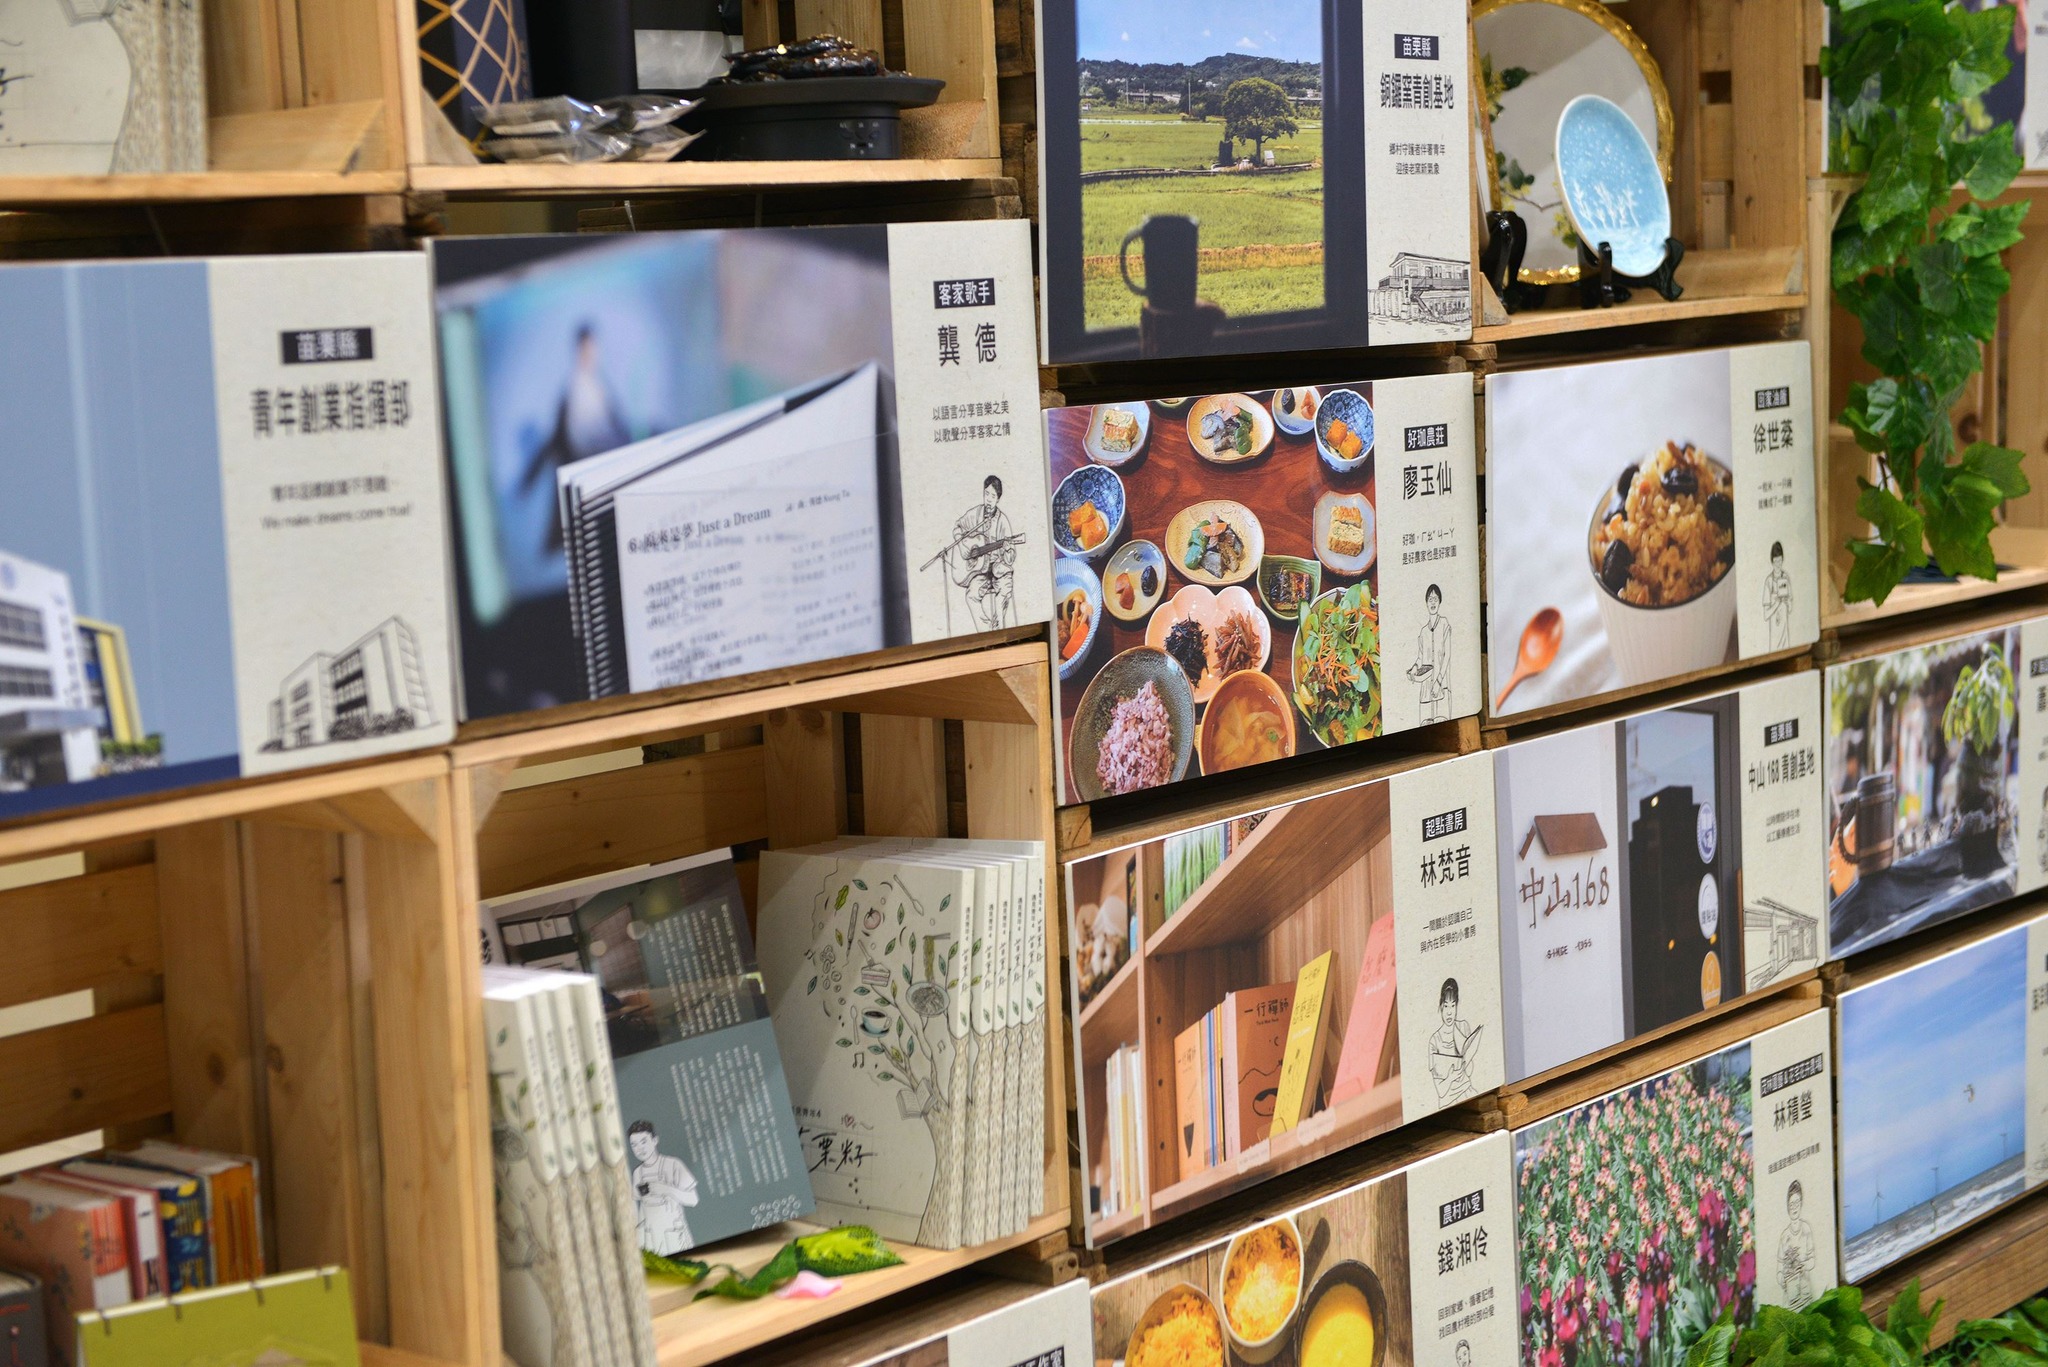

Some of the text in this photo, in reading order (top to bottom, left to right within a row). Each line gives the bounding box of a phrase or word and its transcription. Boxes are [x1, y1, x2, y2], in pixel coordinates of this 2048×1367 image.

[1402, 36, 1432, 57] 苗栗縣
[938, 279, 991, 306] 客家歌手
[932, 400, 1009, 421] 以語言分享音樂之美
[933, 422, 1011, 443] 以歌聲分享客家之情
[1402, 460, 1453, 501] 廖玉仙
[696, 519, 720, 537] Just
[733, 507, 772, 527] Dream
[1425, 809, 1464, 839] 起點書房
[1420, 843, 1471, 889] 林梵音
[1442, 1192, 1481, 1226] 農村小愛
[1437, 1225, 1489, 1277] 錢湘伶
